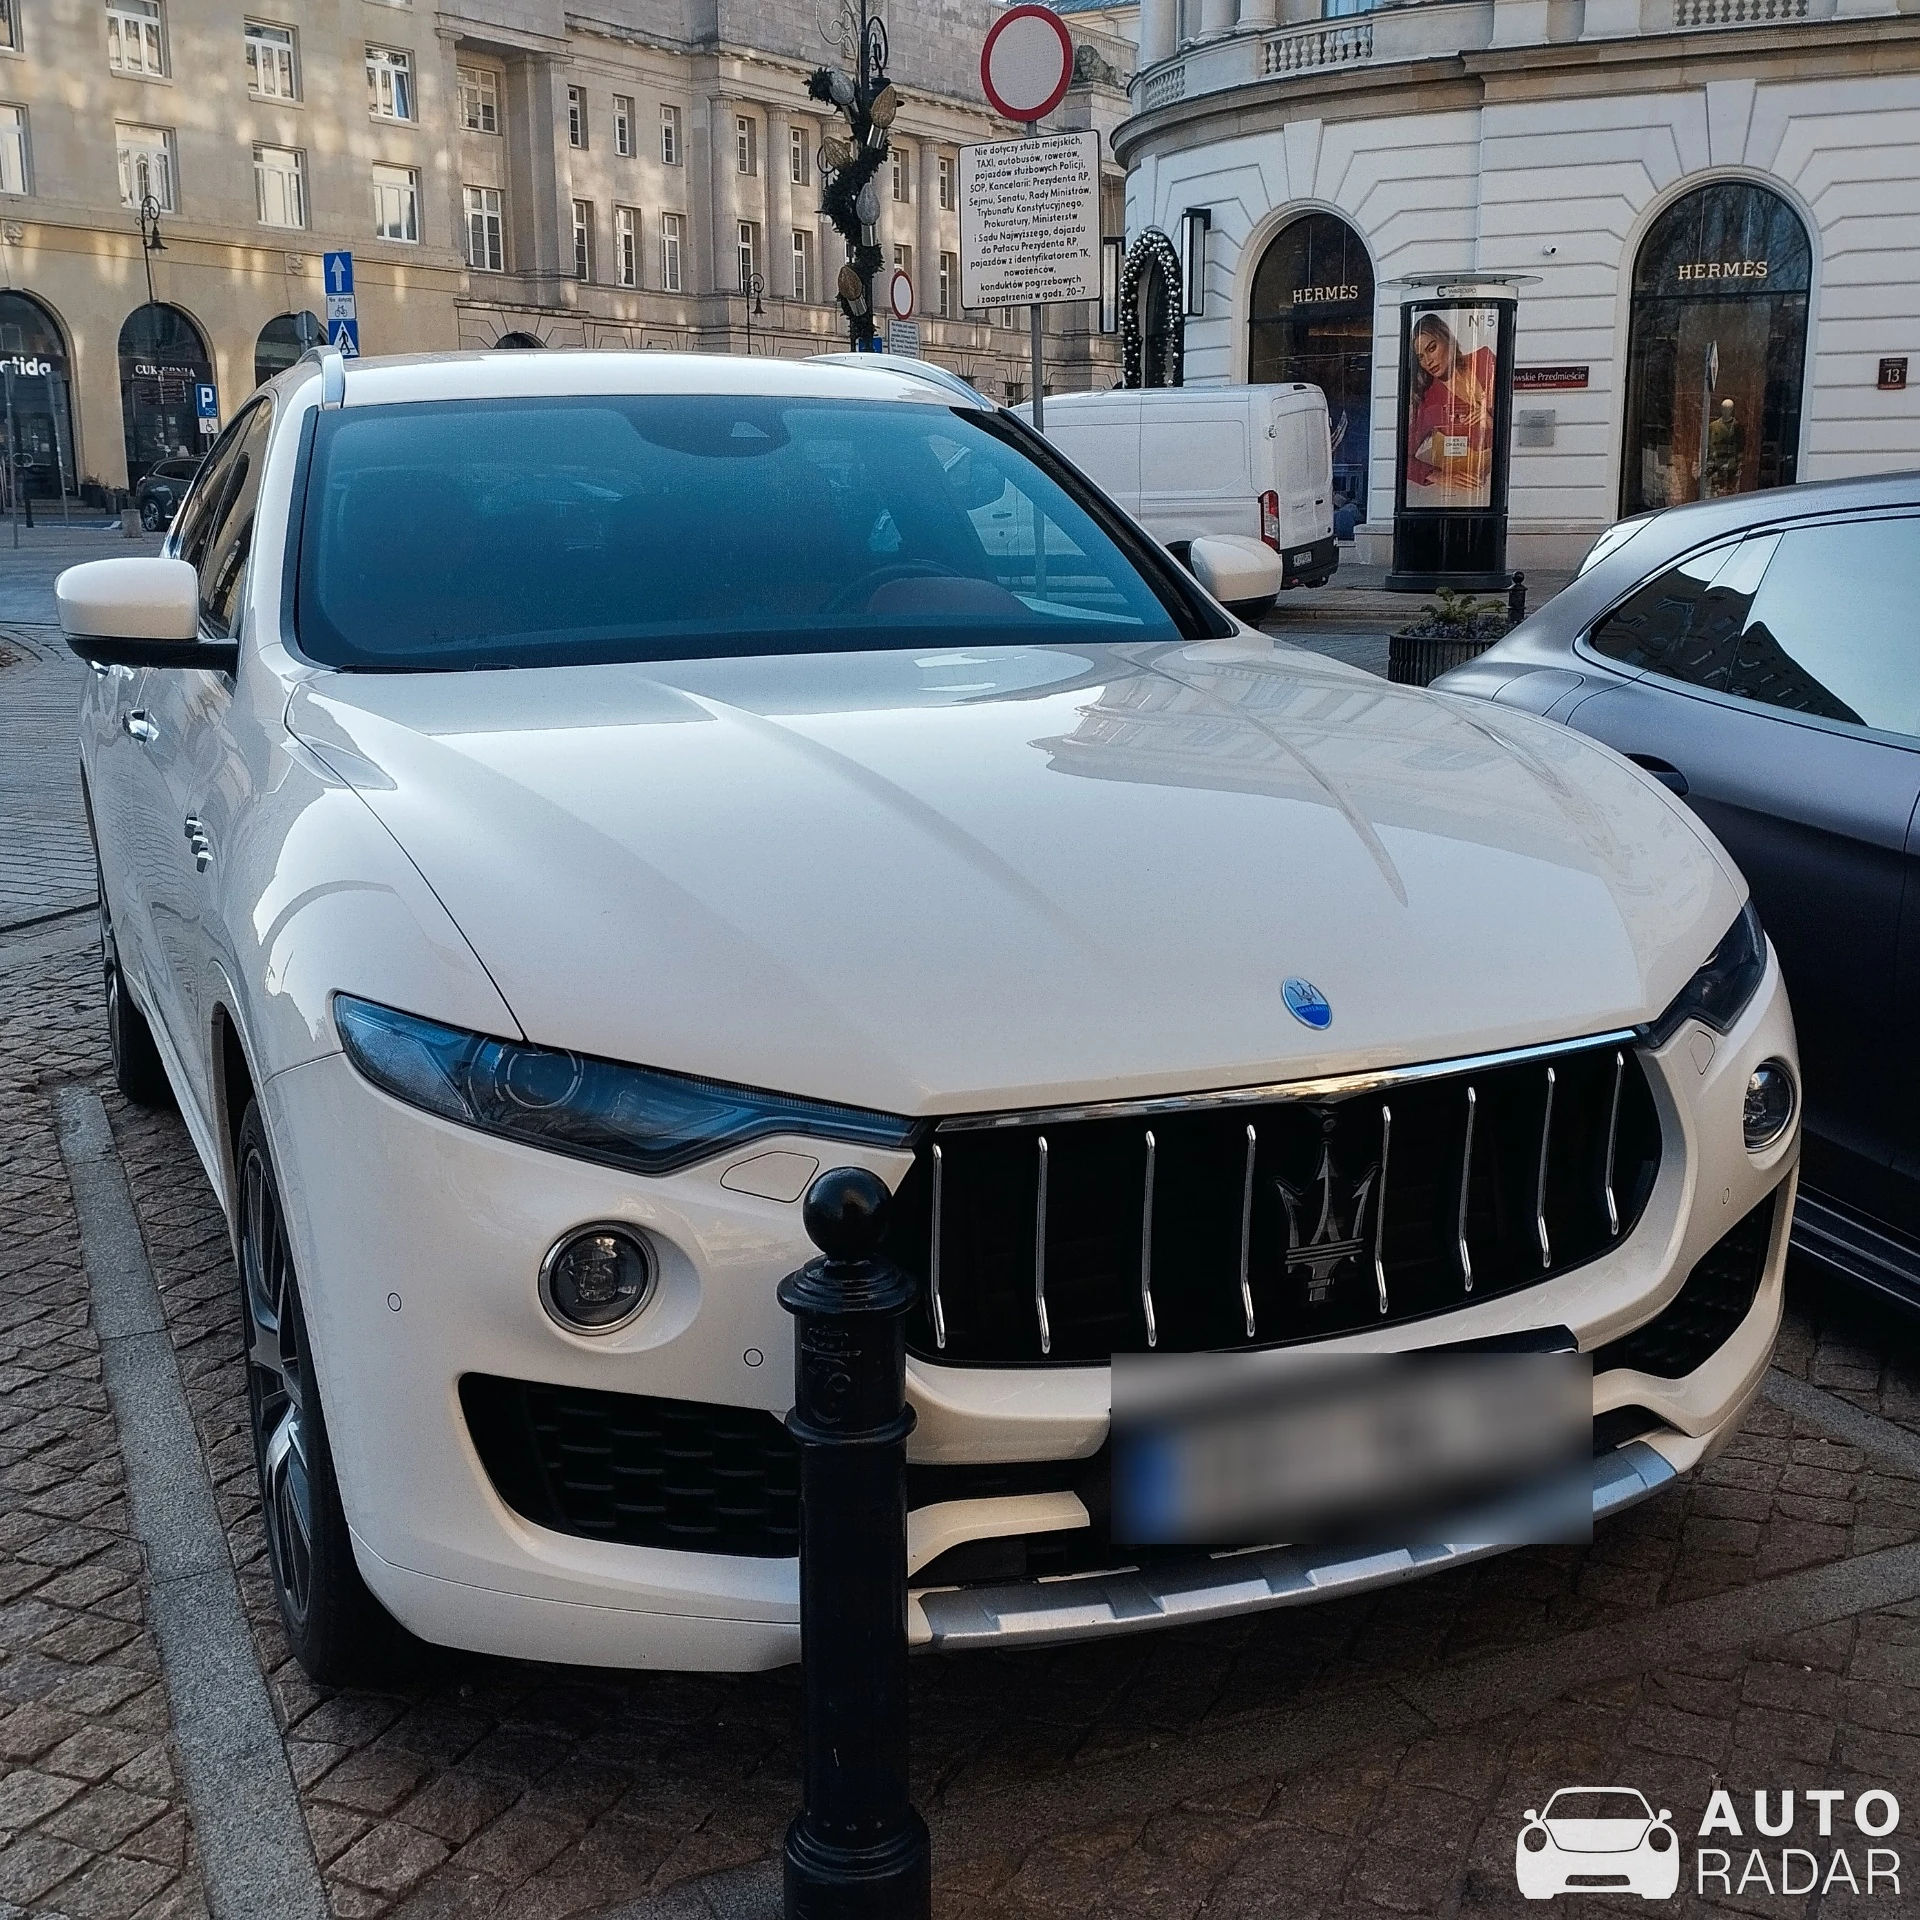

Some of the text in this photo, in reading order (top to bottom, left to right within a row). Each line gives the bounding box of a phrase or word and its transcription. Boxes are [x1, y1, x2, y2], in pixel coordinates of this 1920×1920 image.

[975, 136, 1082, 156] Nie dotyczy służb miejskich,
[977, 151, 1079, 168] TAXI, autobusów, rowerów,
[976, 168, 1012, 182] pojazdów
[1014, 163, 1057, 175] służbowych
[970, 183, 987, 193] SOP,
[1033, 175, 1076, 186] Prezydenta
[969, 186, 1091, 207] Sejmu, Senatu, Rady Ministrów,
[977, 200, 1084, 219] Trybunału Konstytucyjnego,
[984, 212, 1077, 228] Prokuratury, Ministerstw
[1000, 230, 1051, 242] Najwyższego,
[1053, 224, 1085, 236] dojazdu
[982, 246, 991, 254] do
[993, 244, 1019, 253] Pałacu
[1022, 240, 1064, 251] Prezydenta
[971, 257, 1007, 270] pojazdów
[1015, 252, 1078, 264] identyfikatorem
[1079, 248, 1091, 258] TK,
[981, 275, 1081, 291] konduktów pogrzebowych
[982, 291, 1033, 304] zaopatrzenia
[1538, 371, 1586, 381] Przedmieście
[1886, 368, 1900, 382] 13
[201, 387, 213, 408] P
